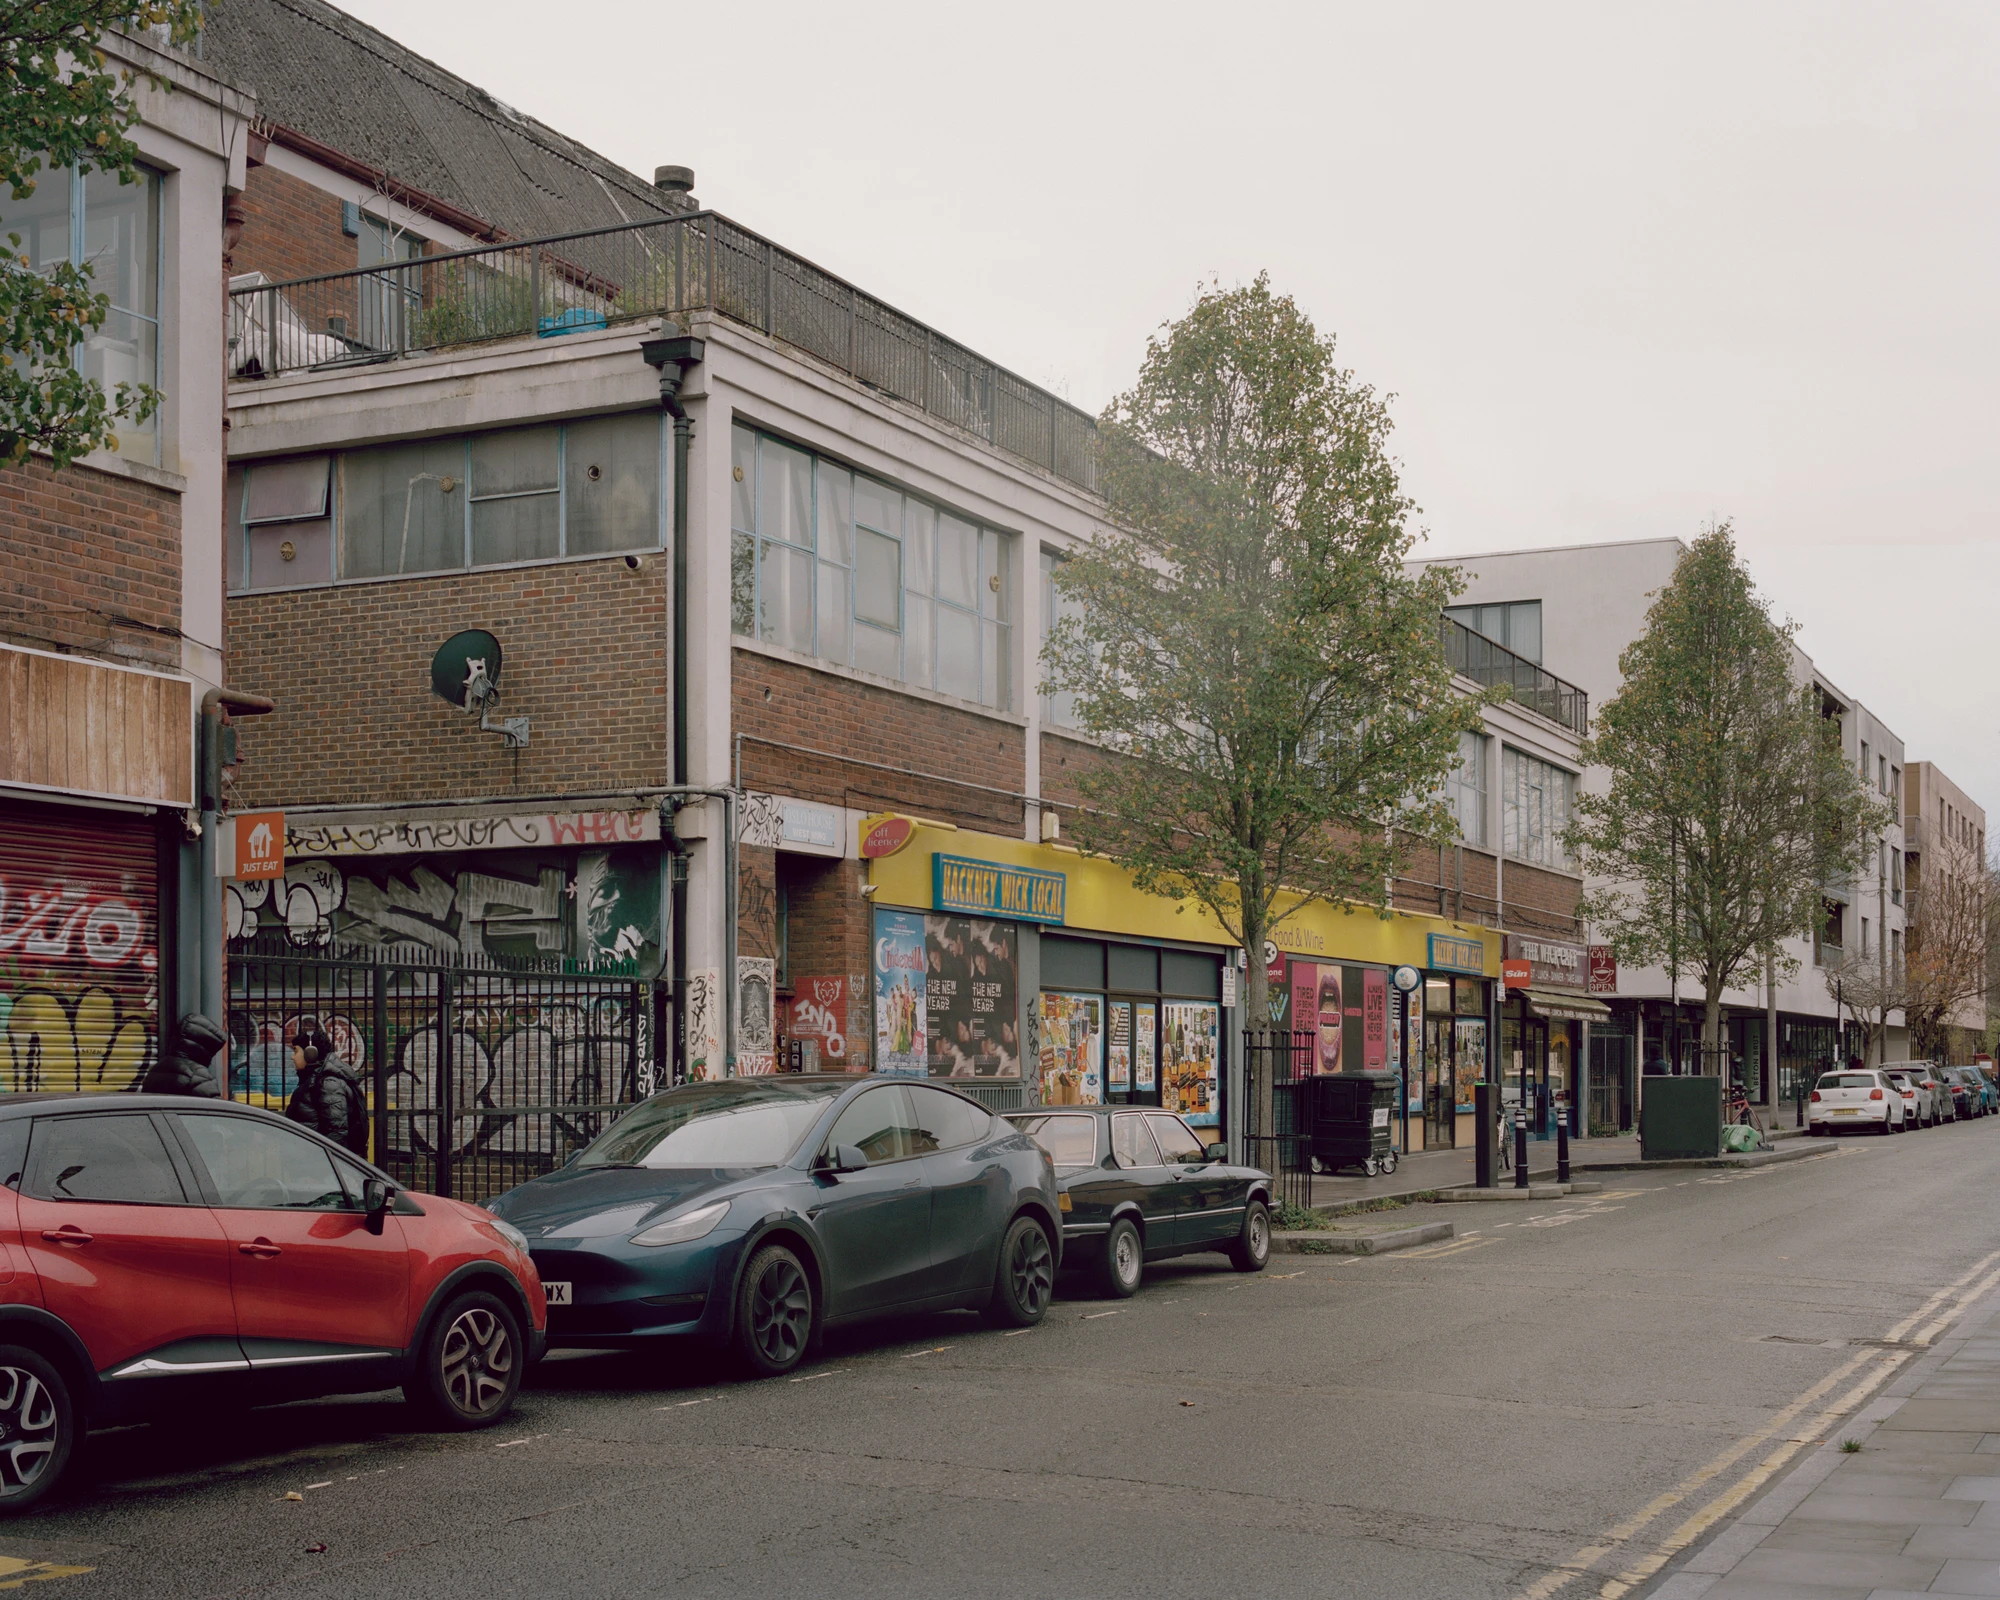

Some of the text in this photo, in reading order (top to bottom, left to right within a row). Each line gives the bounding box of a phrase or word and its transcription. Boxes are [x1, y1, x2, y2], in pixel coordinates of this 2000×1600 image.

[786, 809, 833, 830] OSLO HOUSE
[792, 827, 827, 841] WEST WING
[874, 827, 889, 838] off
[867, 838, 900, 847] licence
[241, 860, 279, 875] JUST EAT
[943, 864, 1063, 916] HACKNEY WICK LOCAL
[1273, 925, 1294, 946] Food
[1295, 927, 1303, 947] &
[1303, 928, 1324, 951] Wine
[927, 979, 957, 994] THE NEW
[972, 982, 1002, 997] THE NEW
[1296, 986, 1314, 999] TIRED
[1590, 983, 1615, 992] OPEN
[1367, 995, 1382, 1011] LIVE
[1296, 1010, 1307, 1019] LEFT
[1296, 1020, 1314, 1031] READ?
[1367, 1022, 1382, 1033] NEVER
[541, 1285, 565, 1302] WX
